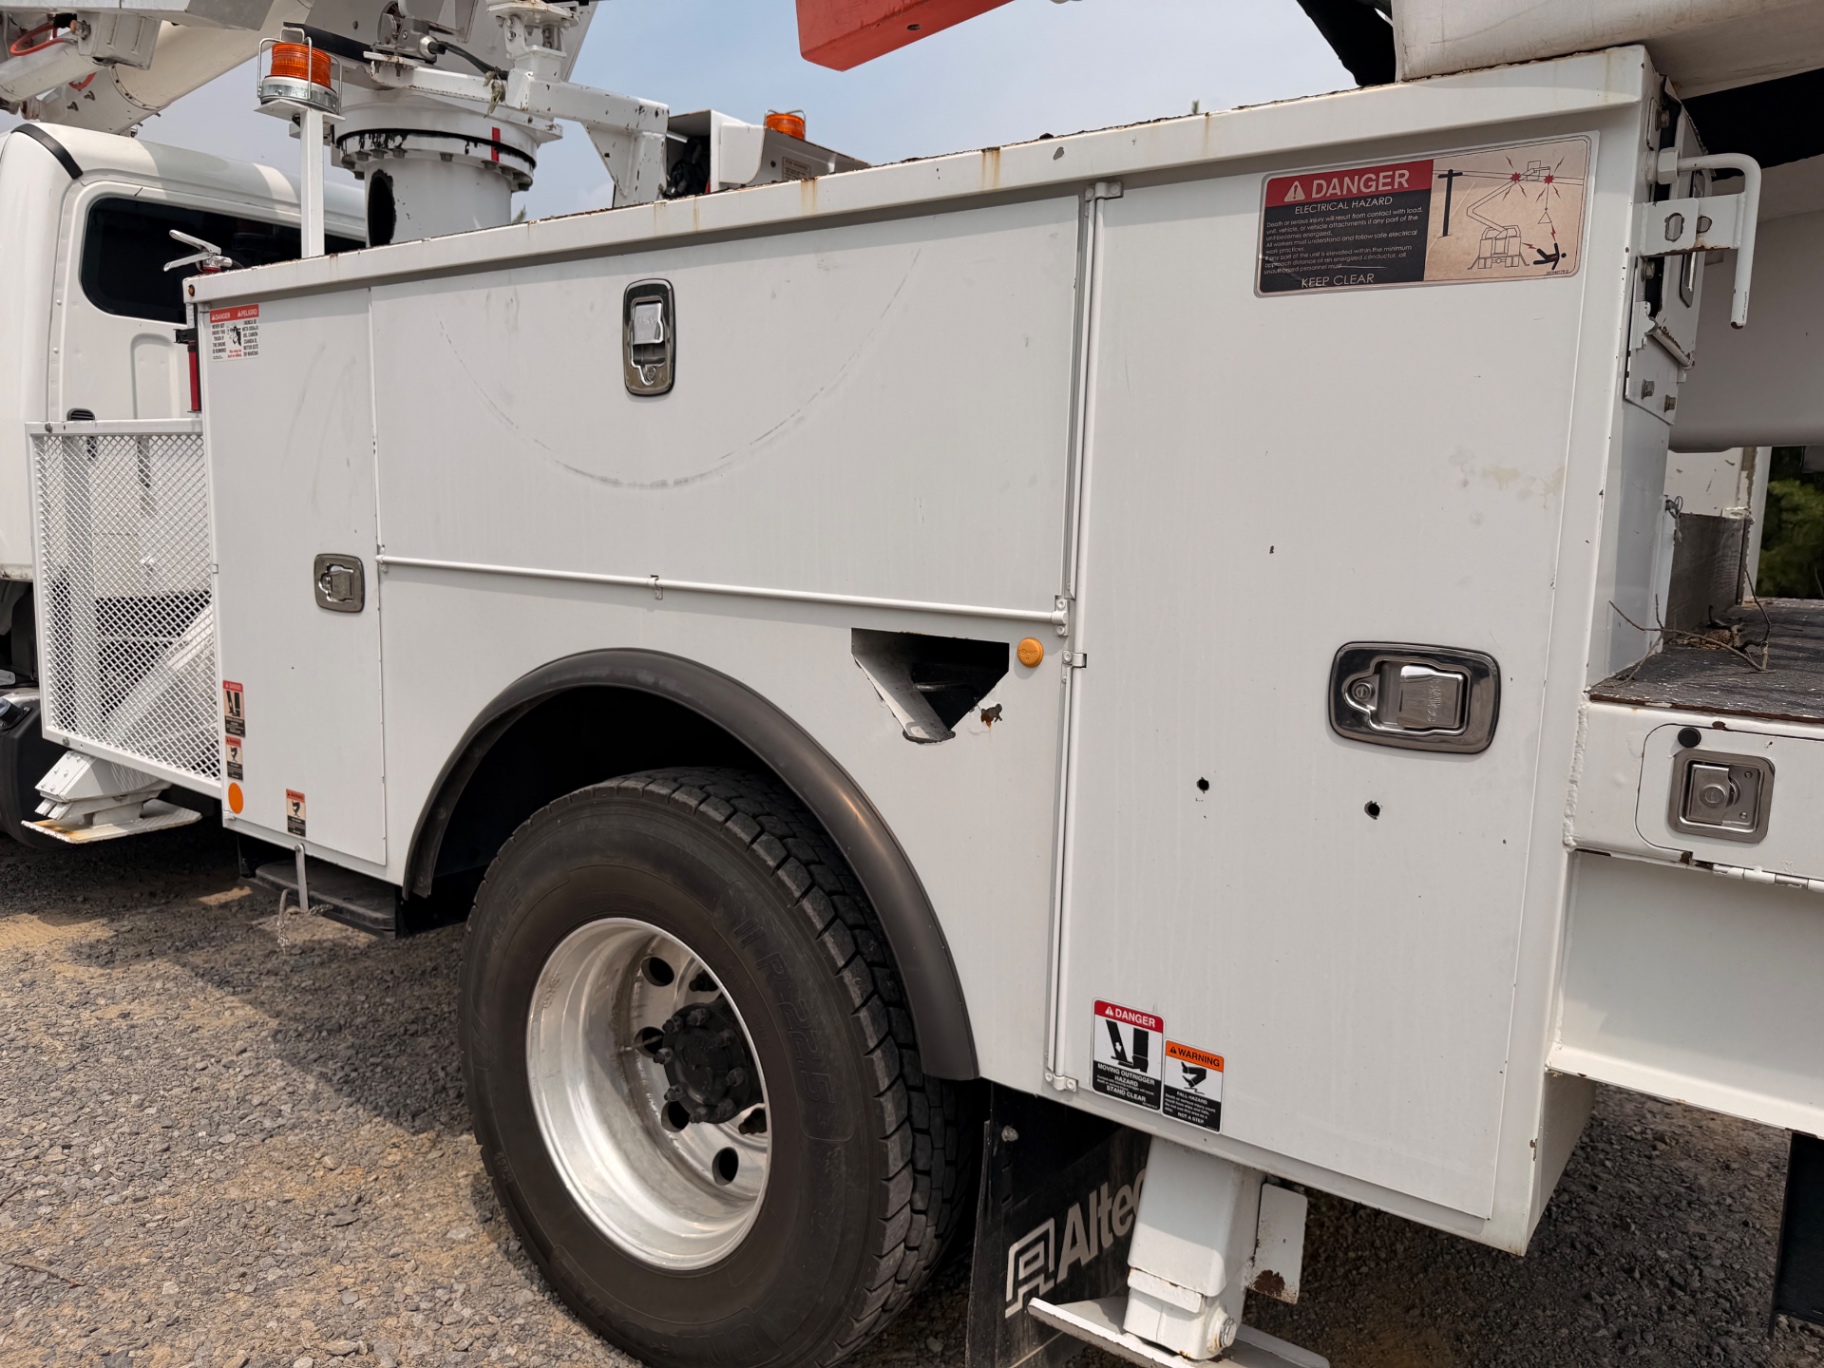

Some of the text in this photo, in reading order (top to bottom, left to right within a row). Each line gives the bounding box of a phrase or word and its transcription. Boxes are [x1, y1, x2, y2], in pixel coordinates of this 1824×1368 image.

[1312, 169, 1410, 199] DANGER
[1295, 196, 1393, 215] ELECTRICAL HAZARD
[1301, 272, 1375, 288] KEEP CLEAR
[1115, 1008, 1156, 1028] DANGER
[1178, 1047, 1220, 1067] WARNING
[1097, 1063, 1155, 1086] MOVING OUTRIGGER
[1114, 1075, 1139, 1087] HAZARD
[1106, 1085, 1146, 1102] STAND CLEAR
[1188, 1094, 1207, 1104] HAZARD
[1192, 1116, 1204, 1124] STEP
